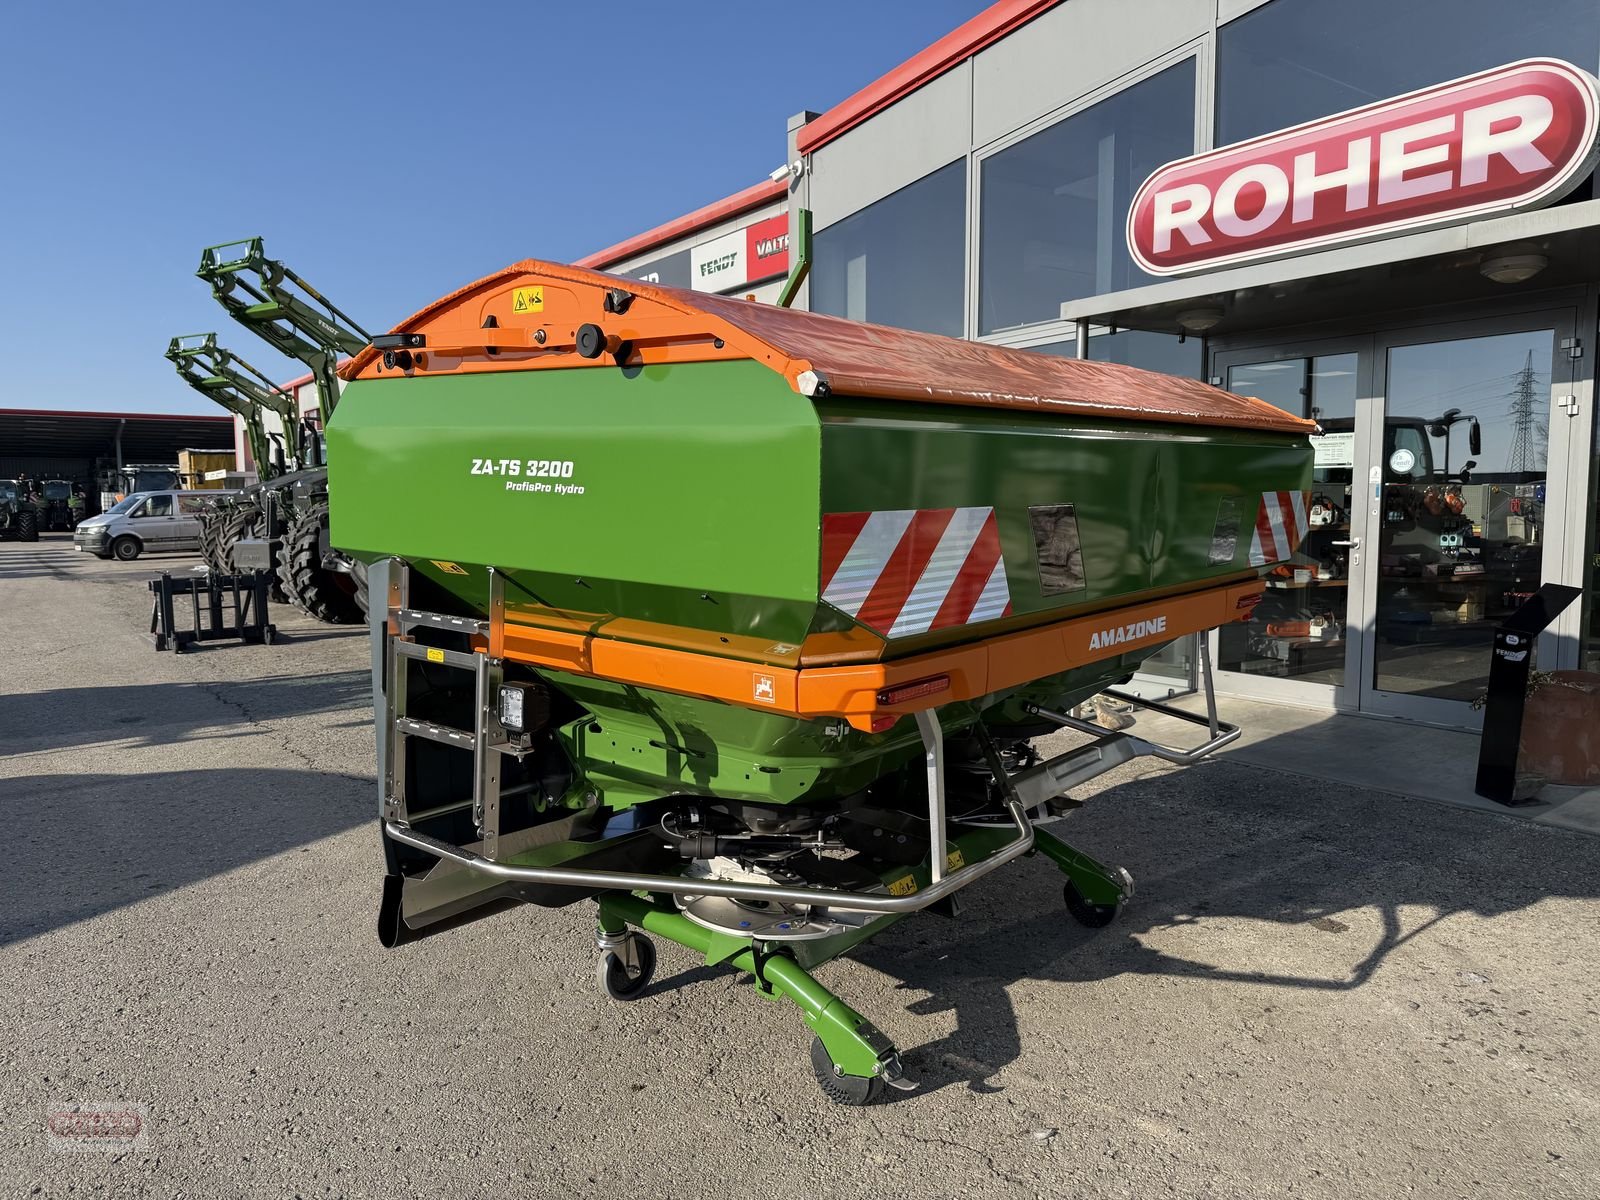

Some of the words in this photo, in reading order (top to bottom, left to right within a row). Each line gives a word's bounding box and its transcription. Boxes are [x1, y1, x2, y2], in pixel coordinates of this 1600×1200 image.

[1152, 94, 1556, 254] ROHER
[700, 252, 738, 277] FENDT
[318, 319, 339, 335] FENDT
[470, 458, 521, 476] ZA-TS
[526, 460, 574, 478] 3200
[505, 481, 552, 492] ProfisPro
[554, 483, 585, 496] Hydro
[1088, 615, 1167, 652] AMAZONE
